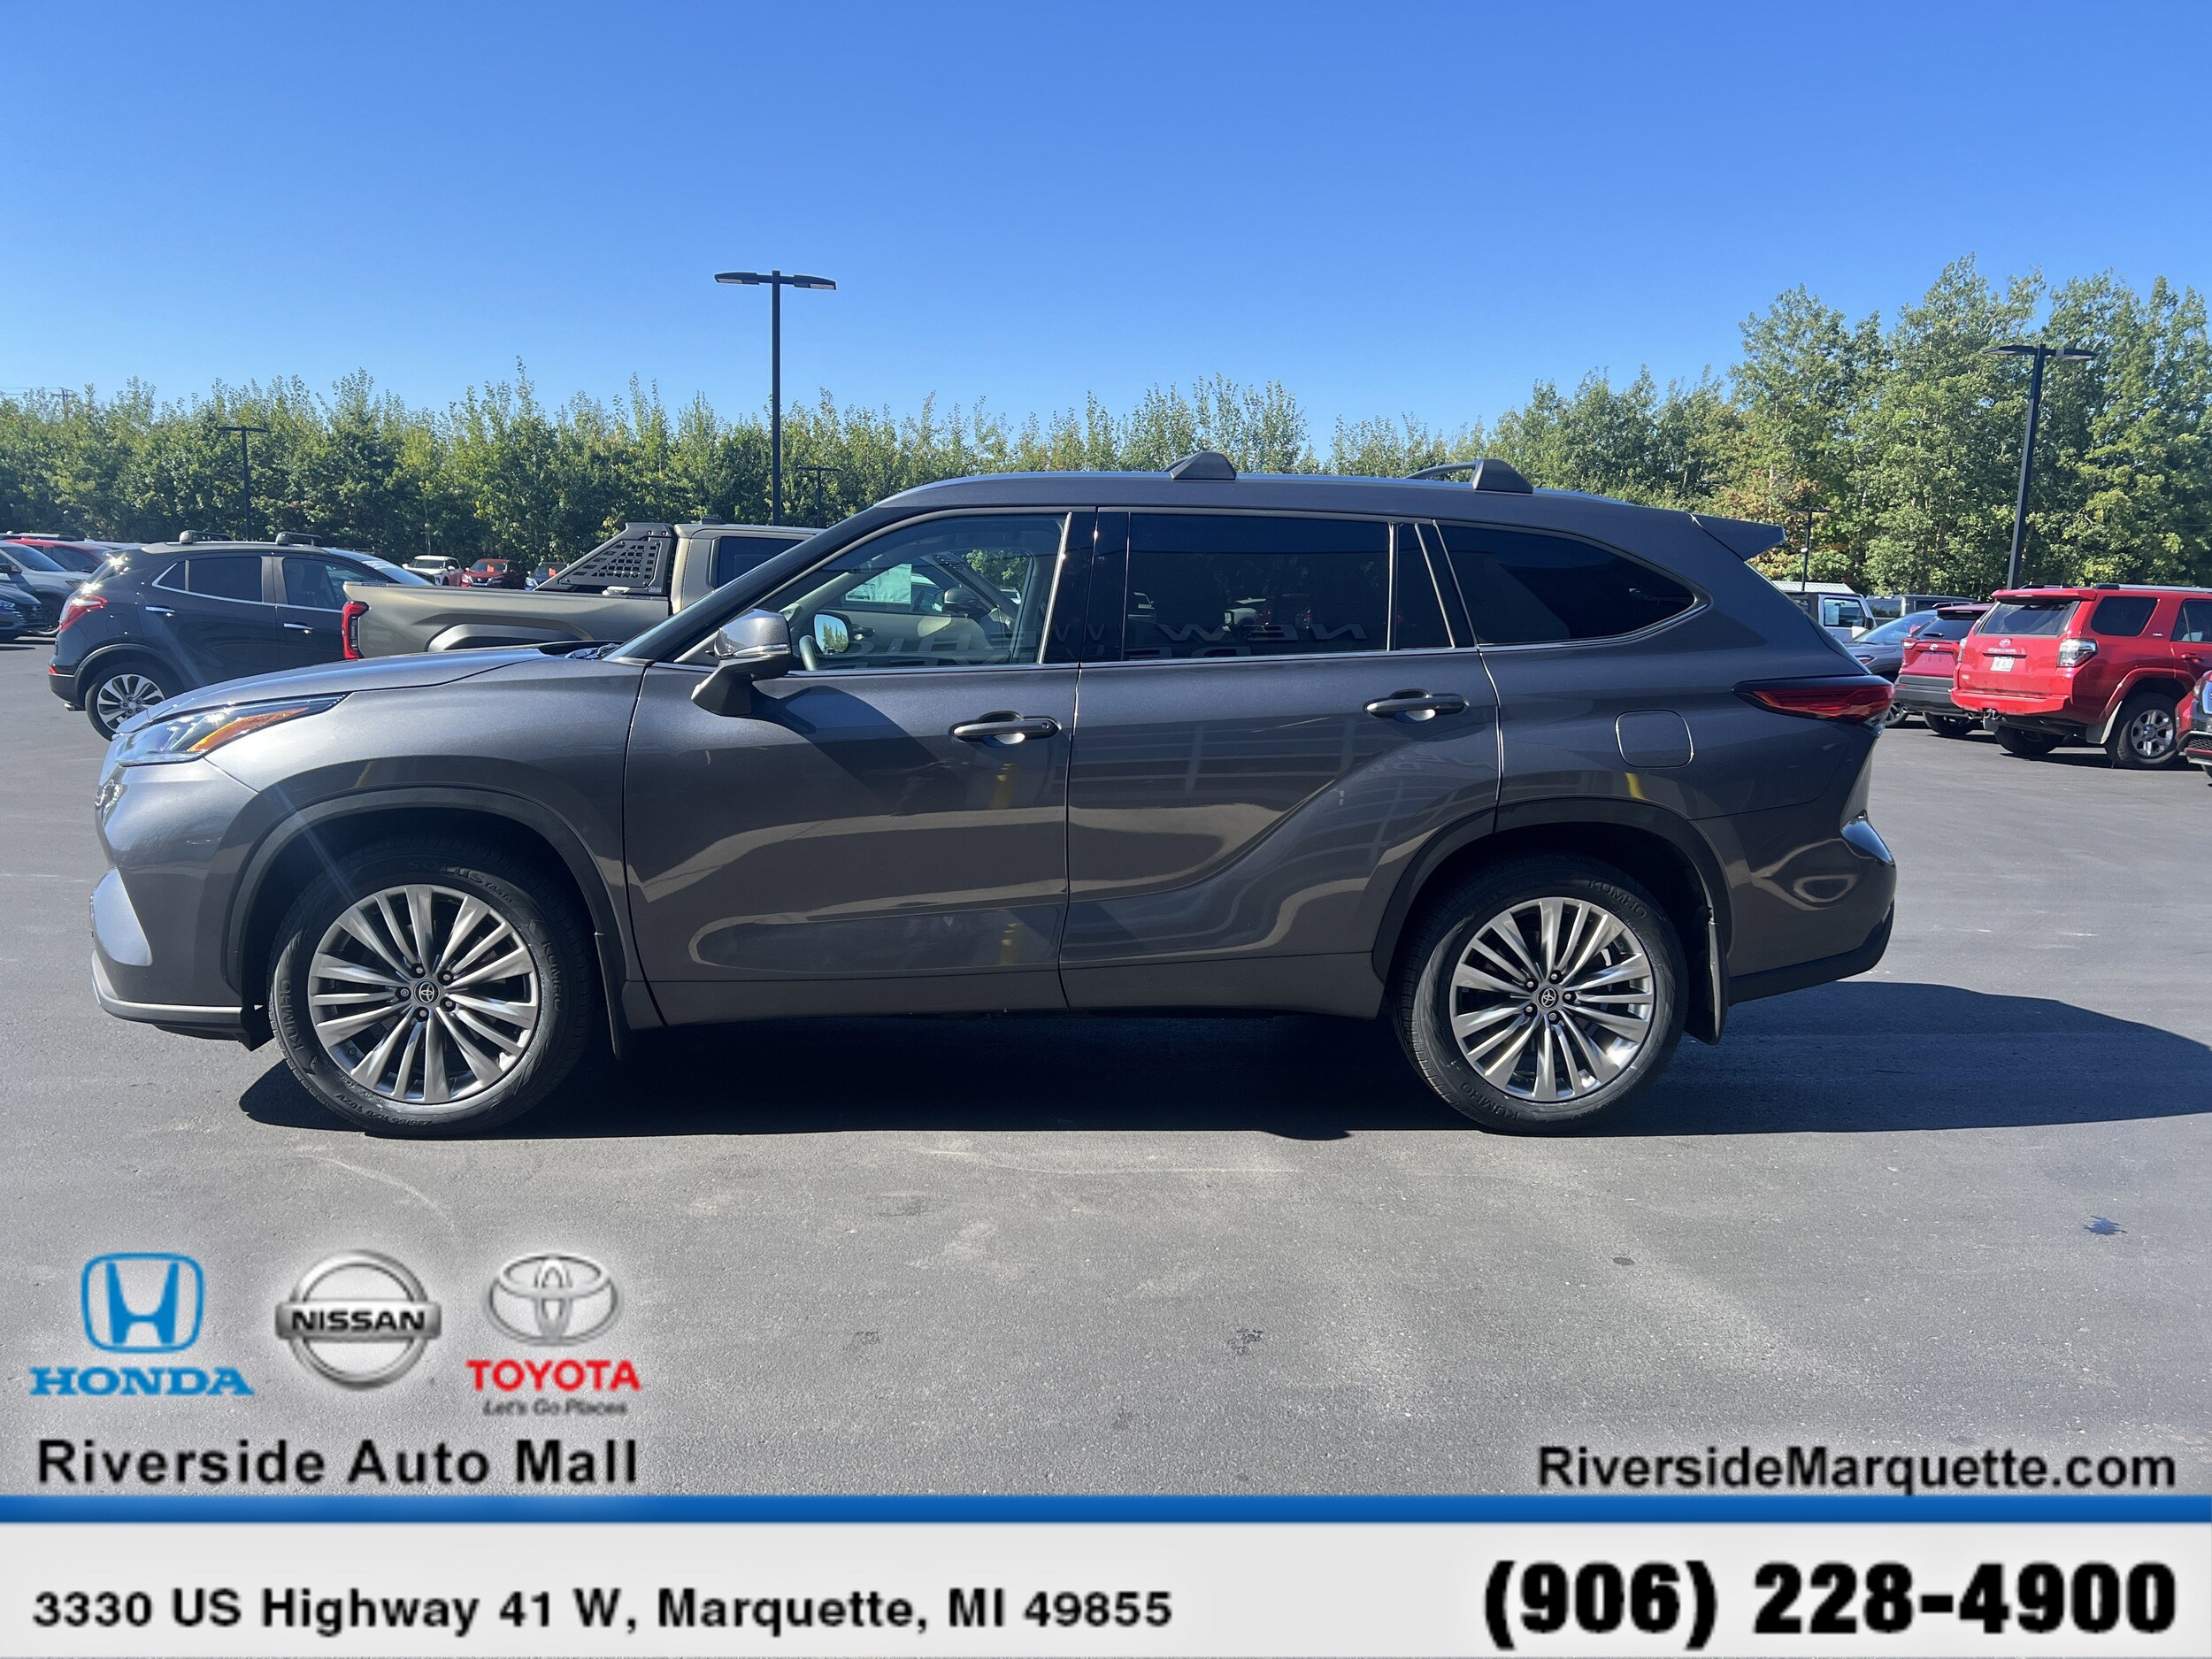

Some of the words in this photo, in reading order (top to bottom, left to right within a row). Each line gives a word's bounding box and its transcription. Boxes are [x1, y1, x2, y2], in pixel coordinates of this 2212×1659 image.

[1588, 879, 1647, 920] KUMHO
[541, 941, 565, 1013] KUMHO
[279, 977, 305, 1051] KUMHO
[1459, 1080, 1522, 1123] KUMHO
